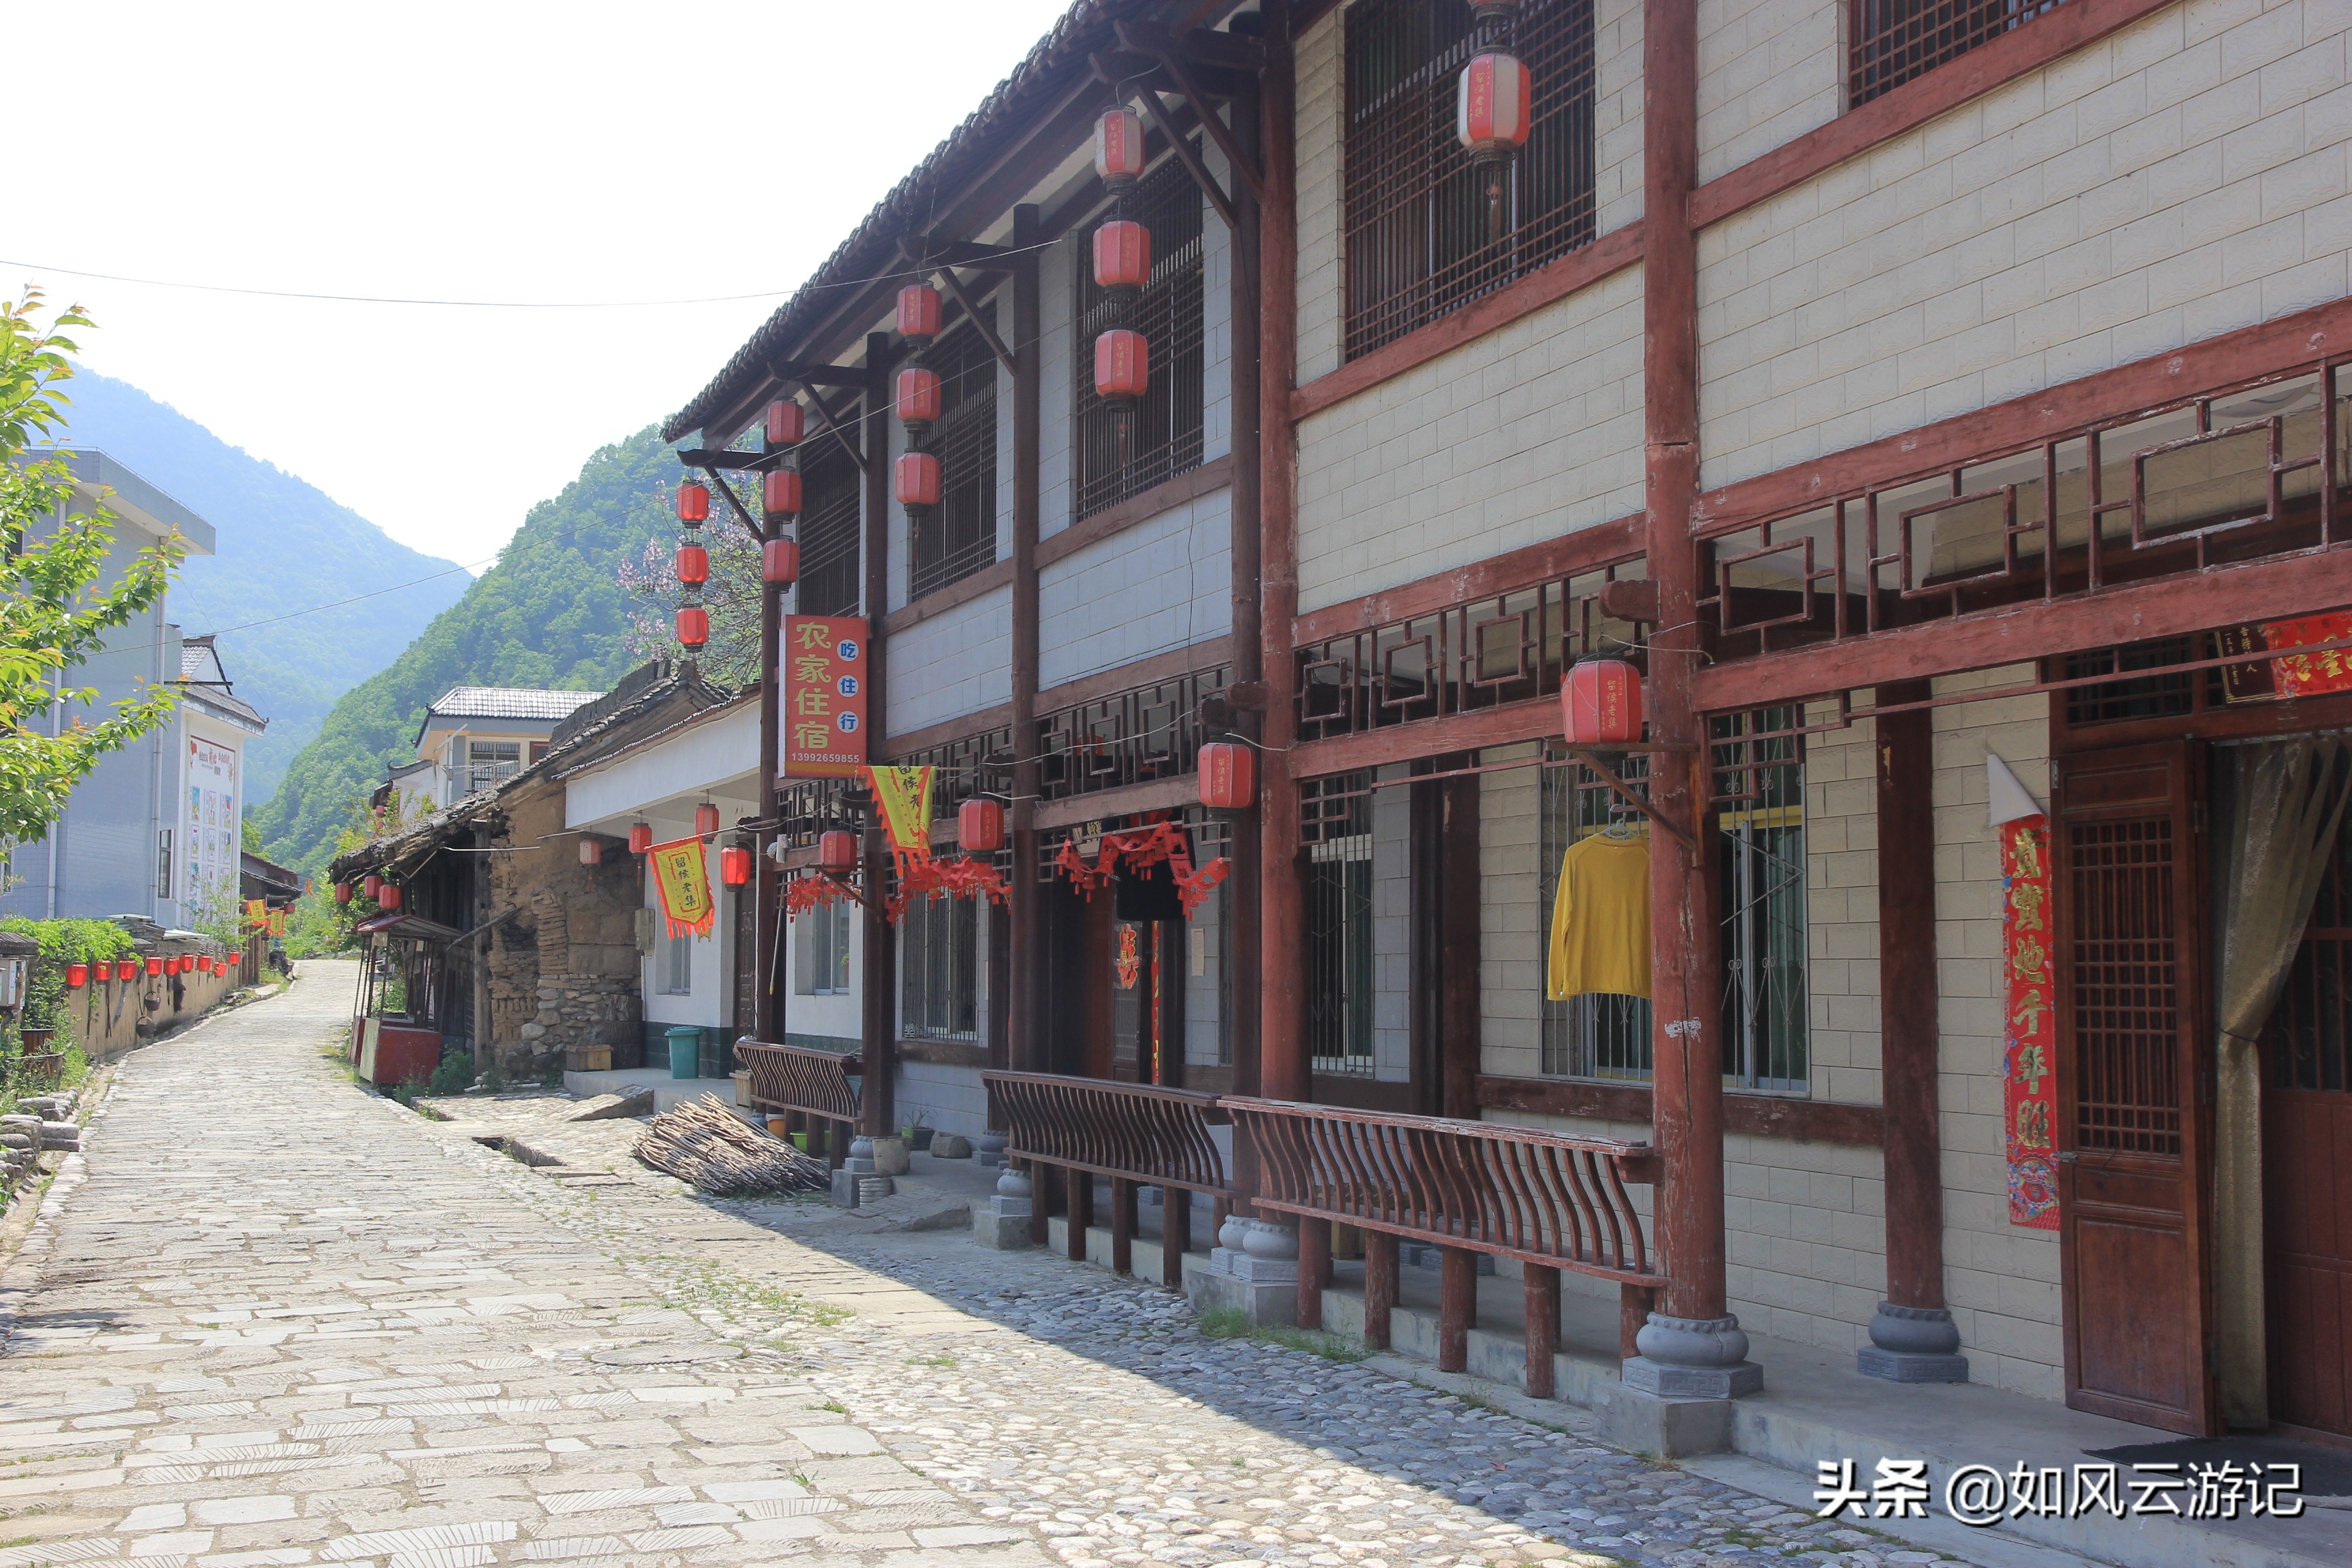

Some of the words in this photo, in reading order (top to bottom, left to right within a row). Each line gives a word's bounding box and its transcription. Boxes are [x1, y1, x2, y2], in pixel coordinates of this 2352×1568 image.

[794, 621, 832, 749] 农家住宿
[840, 642, 857, 730] 吃住行
[1607, 680, 1617, 729] 留侯老集
[791, 753, 860, 763] 13992659855
[898, 766, 920, 811] 留侯老
[675, 857, 696, 906] 留侯老集
